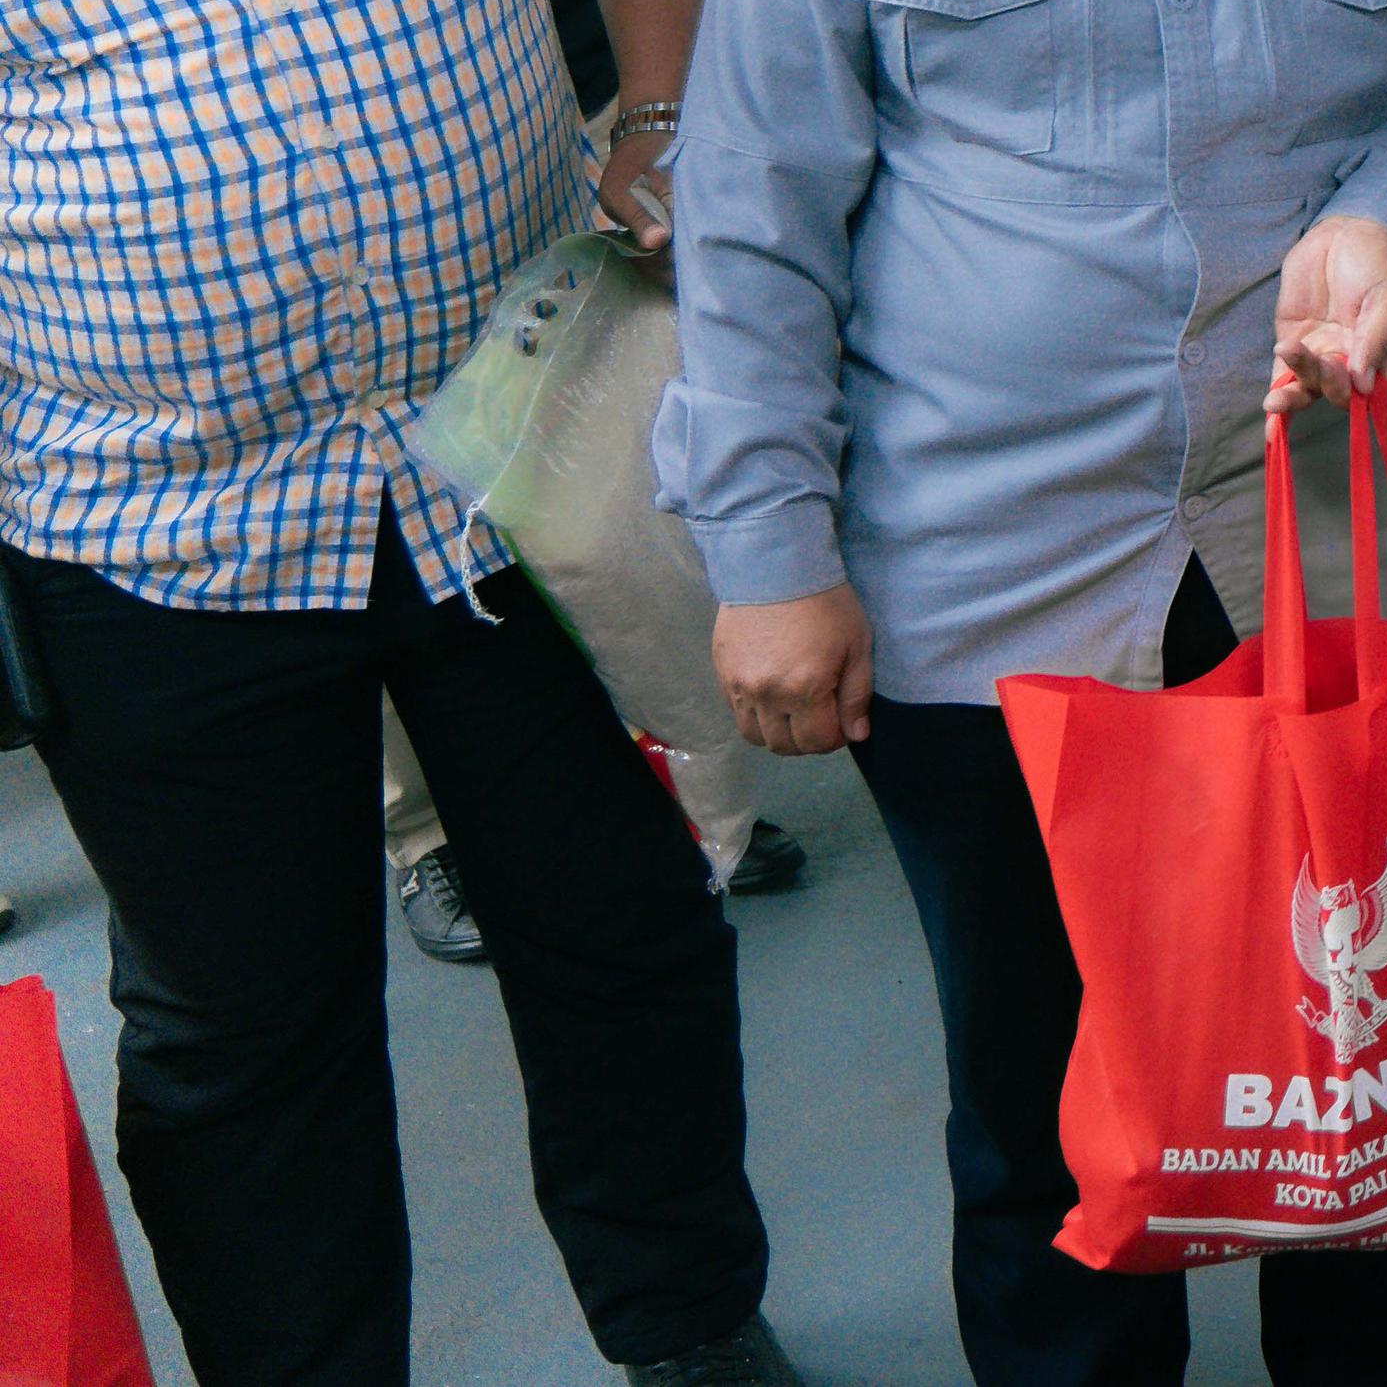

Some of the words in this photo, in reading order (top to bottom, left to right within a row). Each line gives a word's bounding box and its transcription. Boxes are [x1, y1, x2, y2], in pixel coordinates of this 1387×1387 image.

[1161, 1147, 1262, 1174] BADAN
[1264, 1148, 1332, 1181] AMIL
[1273, 1182, 1345, 1212] KOTA
